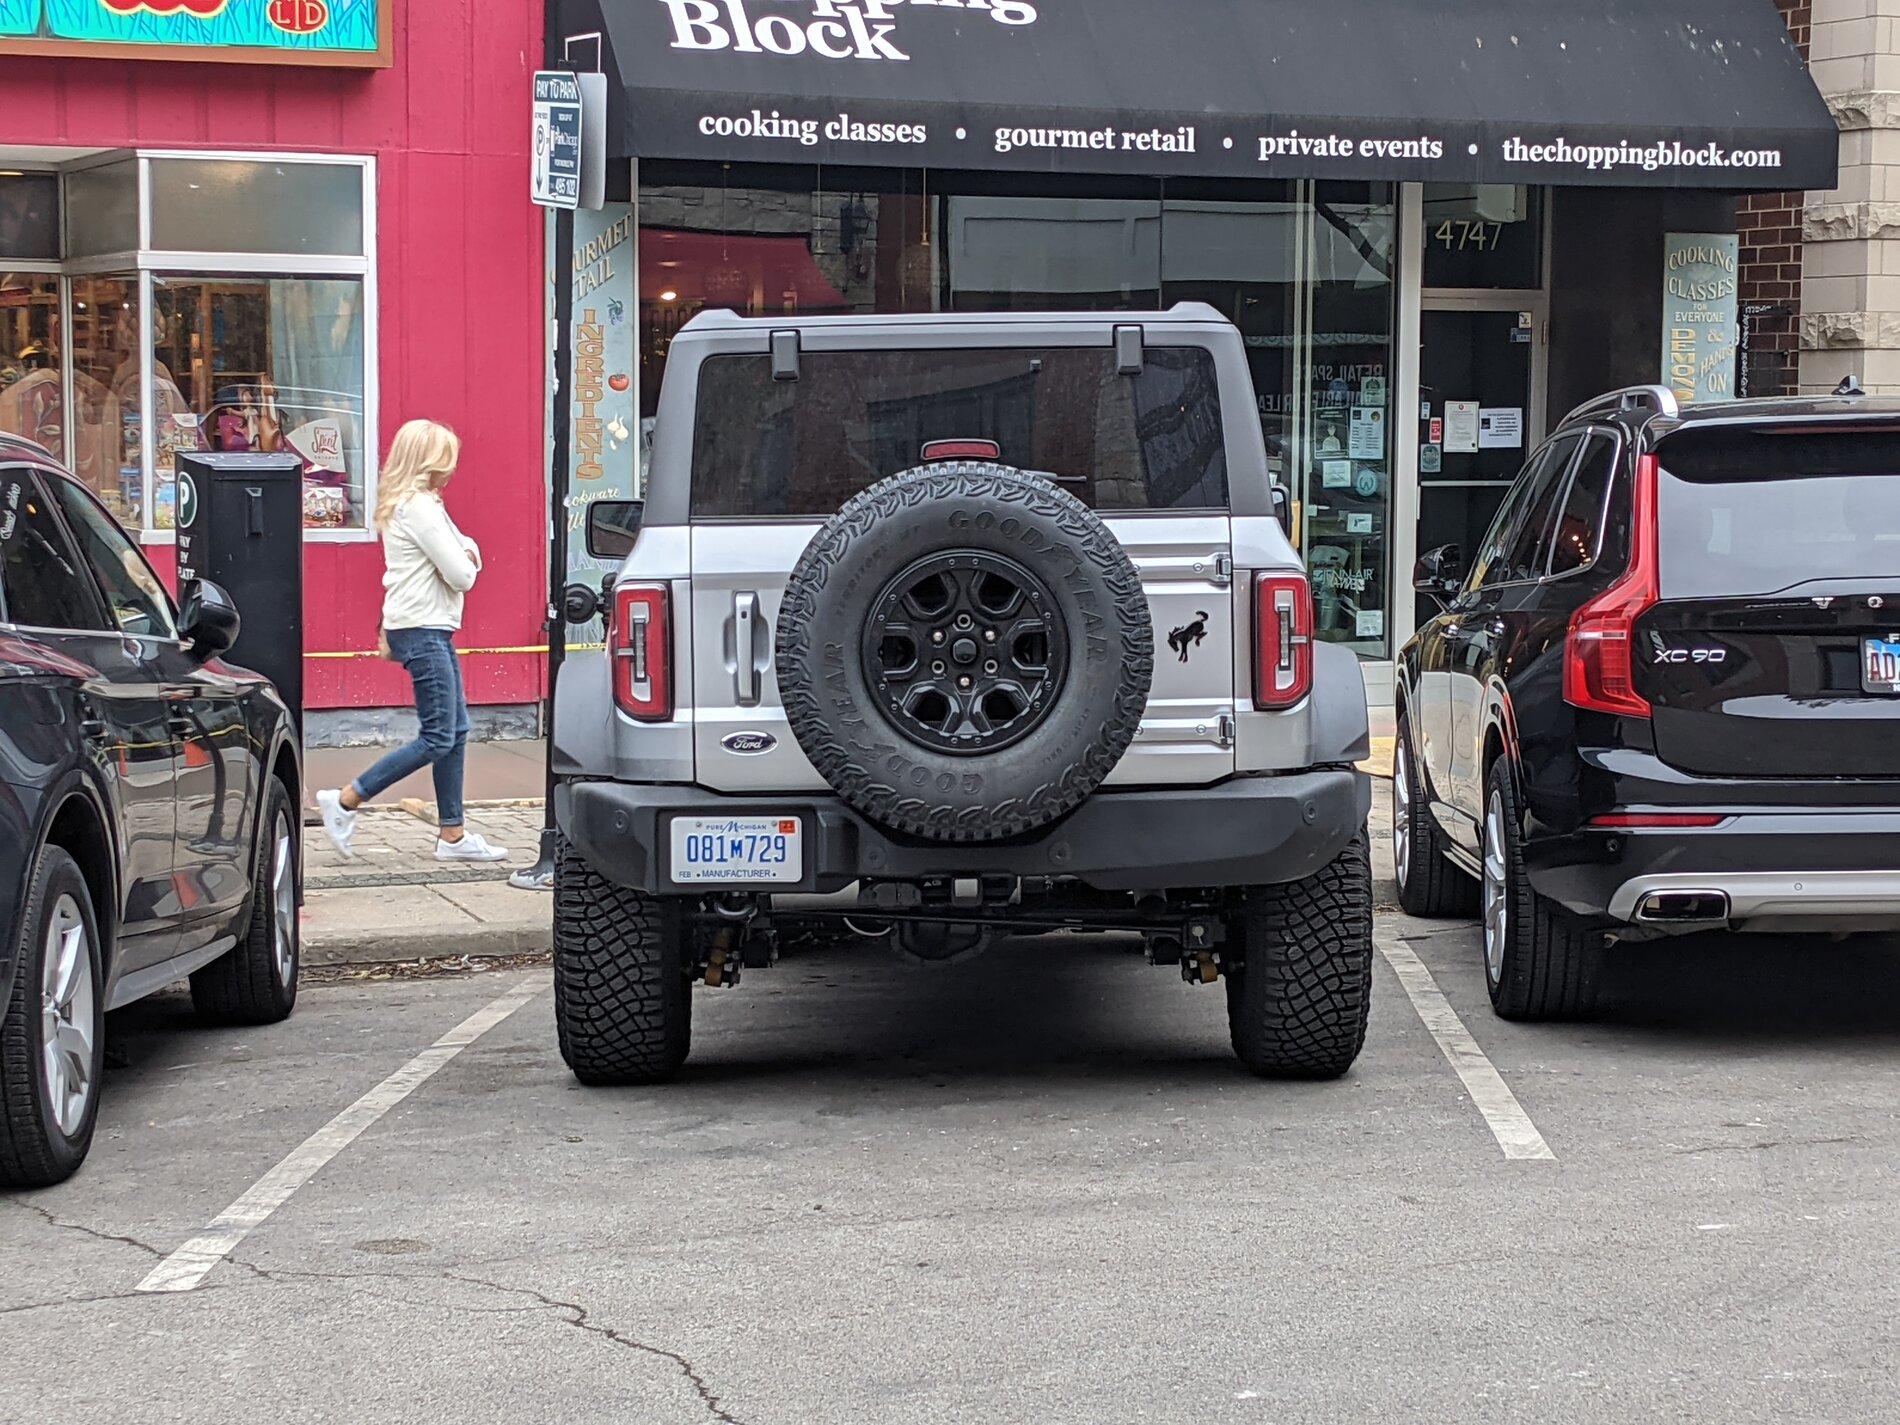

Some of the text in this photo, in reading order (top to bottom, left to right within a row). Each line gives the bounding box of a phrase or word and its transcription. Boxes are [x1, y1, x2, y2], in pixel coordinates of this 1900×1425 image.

[274, 0, 324, 30] LTD
[659, 0, 910, 60] Block
[536, 80, 578, 99] PAY TO PARK
[699, 110, 927, 146] cooking classes
[993, 127, 1196, 153] gourmet retail
[1258, 131, 1443, 162] private events
[1502, 137, 1782, 171] thechoppingblock.com
[1435, 220, 1502, 250] 4747
[1669, 246, 1735, 273] COOKING
[1668, 277, 1735, 301] CLASSES
[1675, 311, 1725, 323] EVERYONE
[1701, 343, 1735, 377] HANDS
[575, 309, 606, 480] INGREDIENTS
[1708, 373, 1727, 393] ON
[733, 736, 763, 749] Ford
[702, 869, 771, 878] MANUFACTURER
